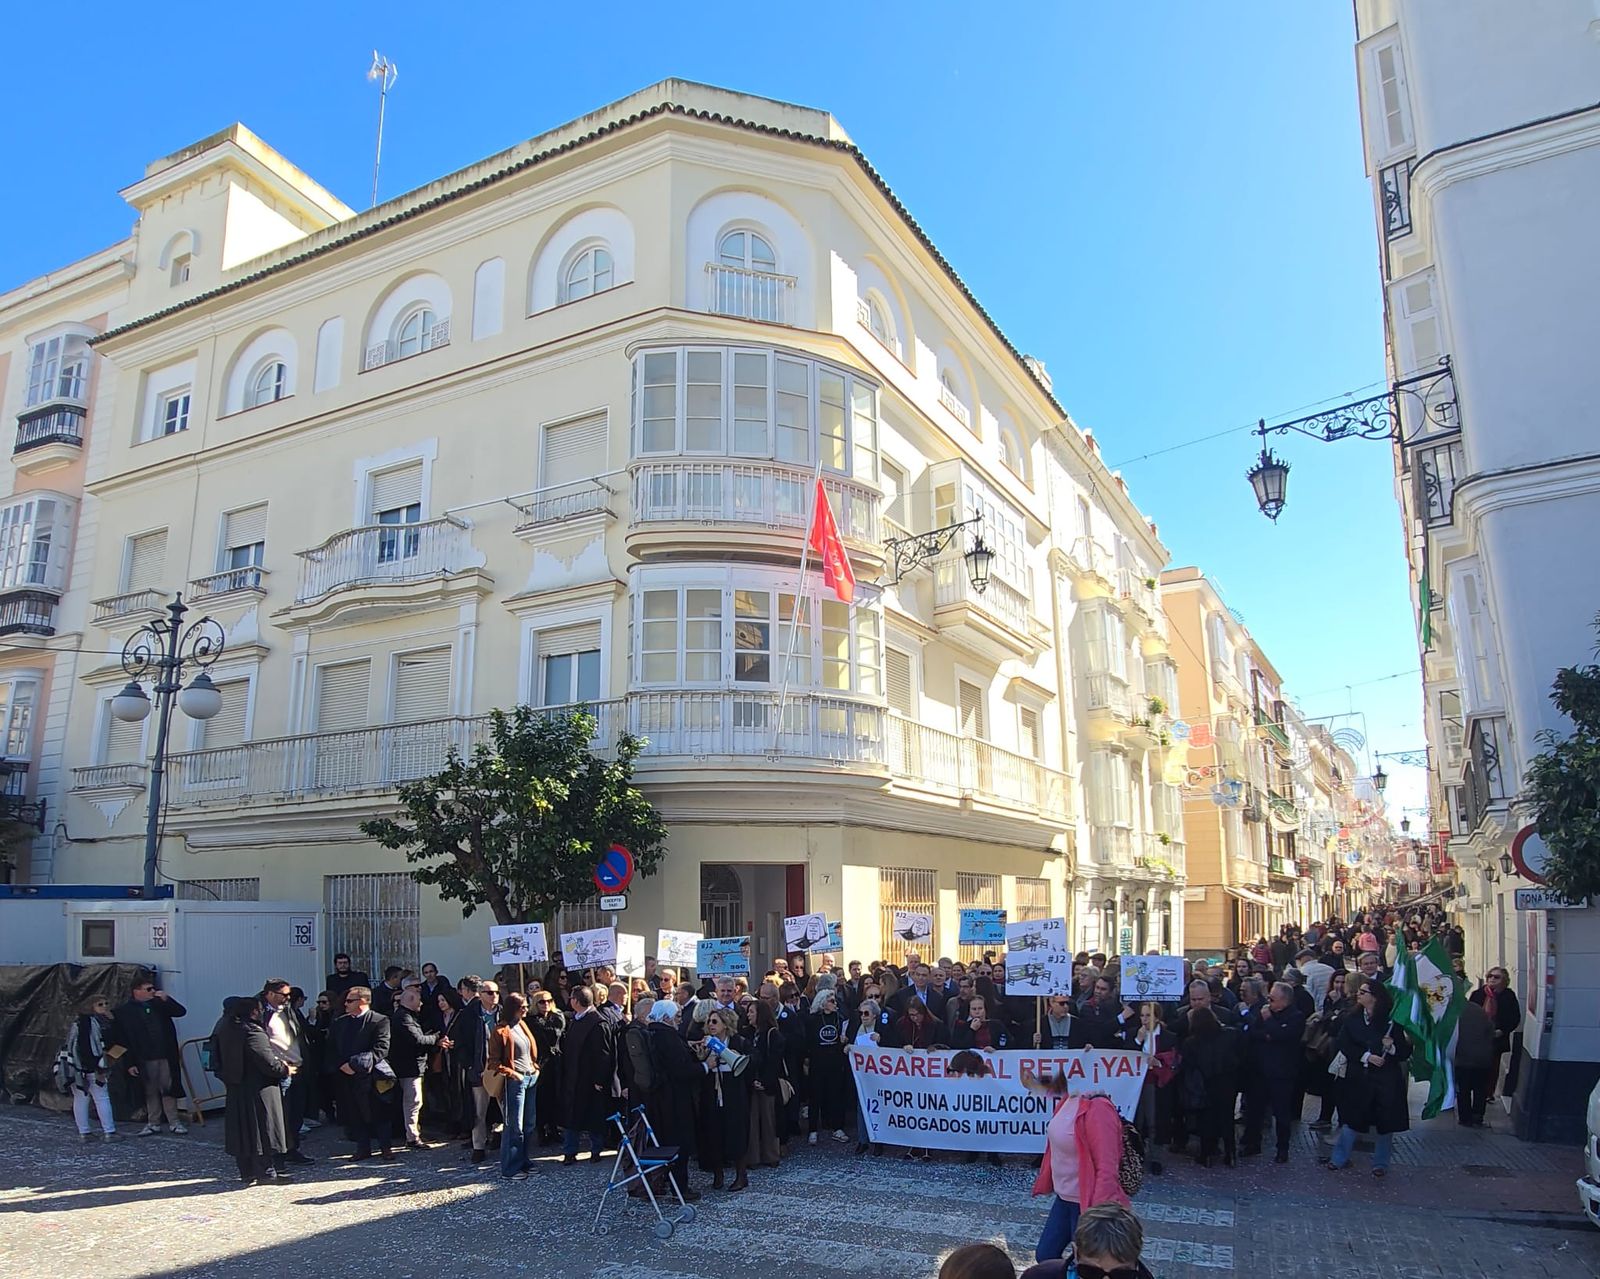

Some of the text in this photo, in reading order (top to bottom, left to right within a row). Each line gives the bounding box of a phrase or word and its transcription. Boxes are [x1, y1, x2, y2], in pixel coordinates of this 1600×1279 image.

[523, 926, 539, 935] #J2
[1043, 920, 1060, 930] #J2
[1047, 955, 1066, 964] #J2
[853, 1052, 976, 1078] PASAREL
[1093, 1056, 1142, 1084] ¡YA!
[917, 1092, 949, 1112] UNA
[952, 1091, 1047, 1114] JUBILACIÓN
[888, 1113, 971, 1134] ABOGADOS
